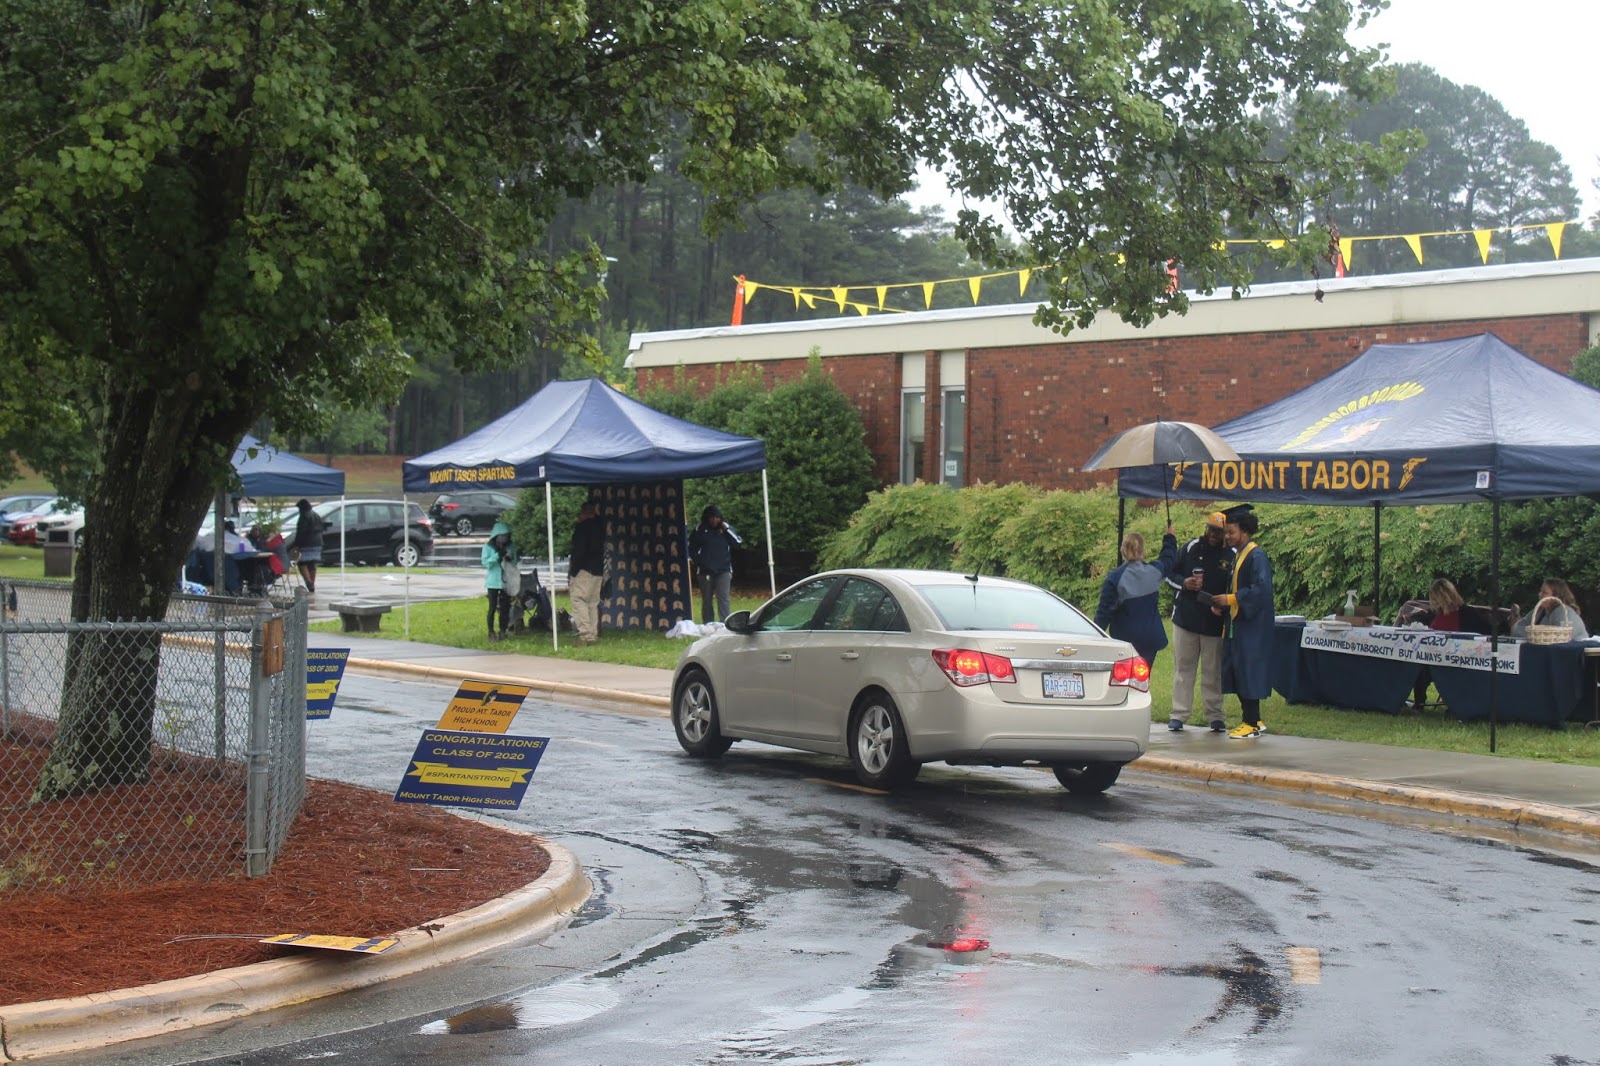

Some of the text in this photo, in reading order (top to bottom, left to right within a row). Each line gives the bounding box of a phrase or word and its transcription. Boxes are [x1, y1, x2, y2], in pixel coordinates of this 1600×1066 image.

[430, 466, 516, 484] MOUNT TABOR SPARTANS
[1201, 460, 1390, 489] MOUNT TABOR
[1398, 648, 1414, 660] BUT
[1416, 651, 1442, 662] ALWAYS
[1044, 680, 1082, 692] RAR-9776
[452, 704, 476, 714] PROUD
[490, 708, 512, 717] TABOR
[453, 716, 498, 726] HIGH SCHOOL
[425, 734, 544, 748] CONGRATULATIONS!
[432, 748, 473, 758] CLASS
[494, 752, 525, 760] 2020
[426, 772, 510, 782] #SPARTANSTRONG
[400, 792, 516, 806] MOUNT TABOR HIGH SCHOOL
